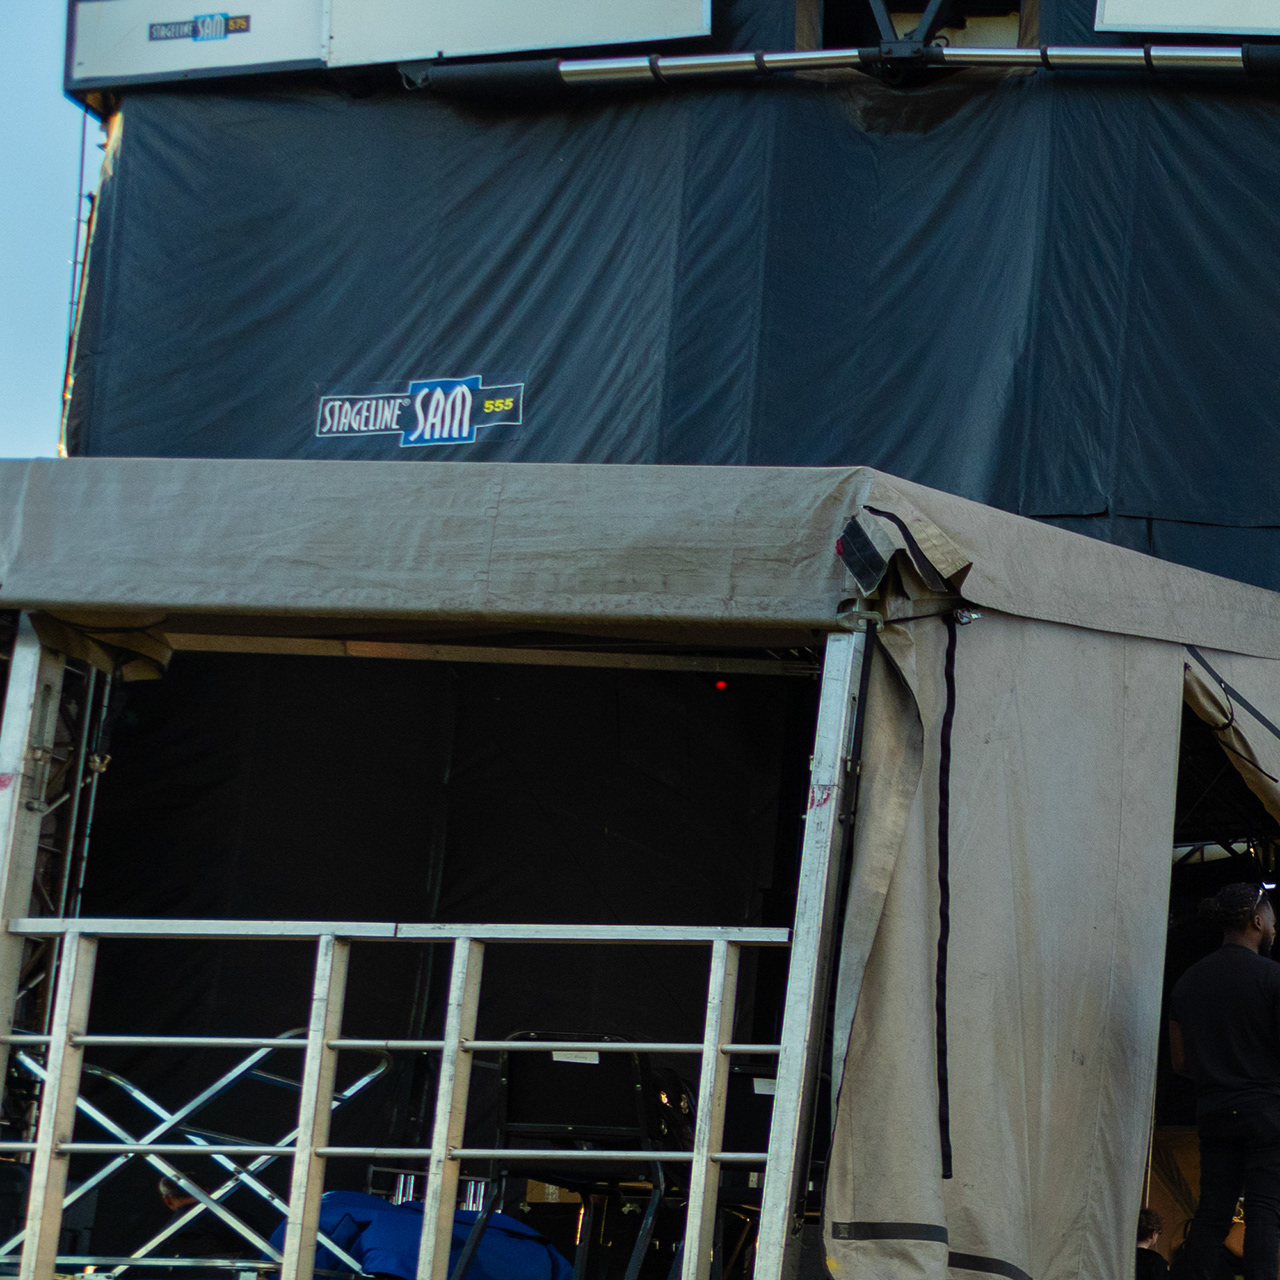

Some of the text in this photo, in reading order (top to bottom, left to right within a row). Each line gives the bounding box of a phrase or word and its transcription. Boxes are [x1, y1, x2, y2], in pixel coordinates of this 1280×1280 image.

[197, 14, 225, 38] SAM
[409, 384, 473, 442] SAM
[483, 398, 514, 413] 555
